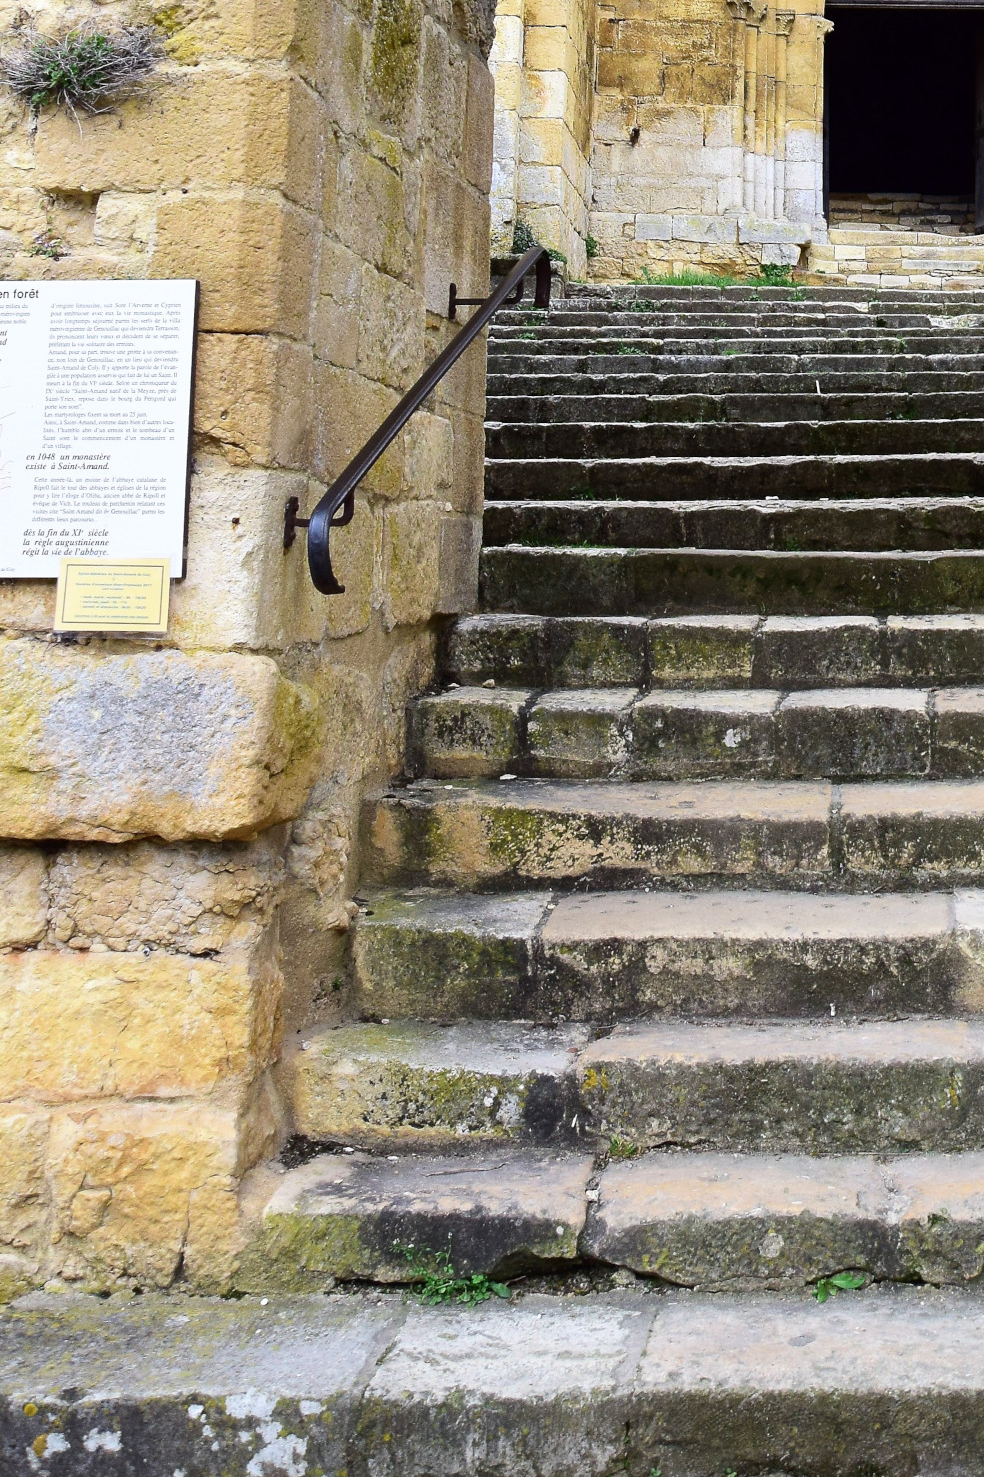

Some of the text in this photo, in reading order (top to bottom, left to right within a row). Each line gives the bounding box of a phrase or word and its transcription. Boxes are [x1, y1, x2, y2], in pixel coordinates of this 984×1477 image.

[14, 288, 38, 298] forêt
[46, 528, 58, 537] fin
[34, 538, 53, 548] règle
[55, 538, 109, 548] augustinienne
[22, 548, 40, 558] régit
[74, 548, 108, 558] l'abbaye.
